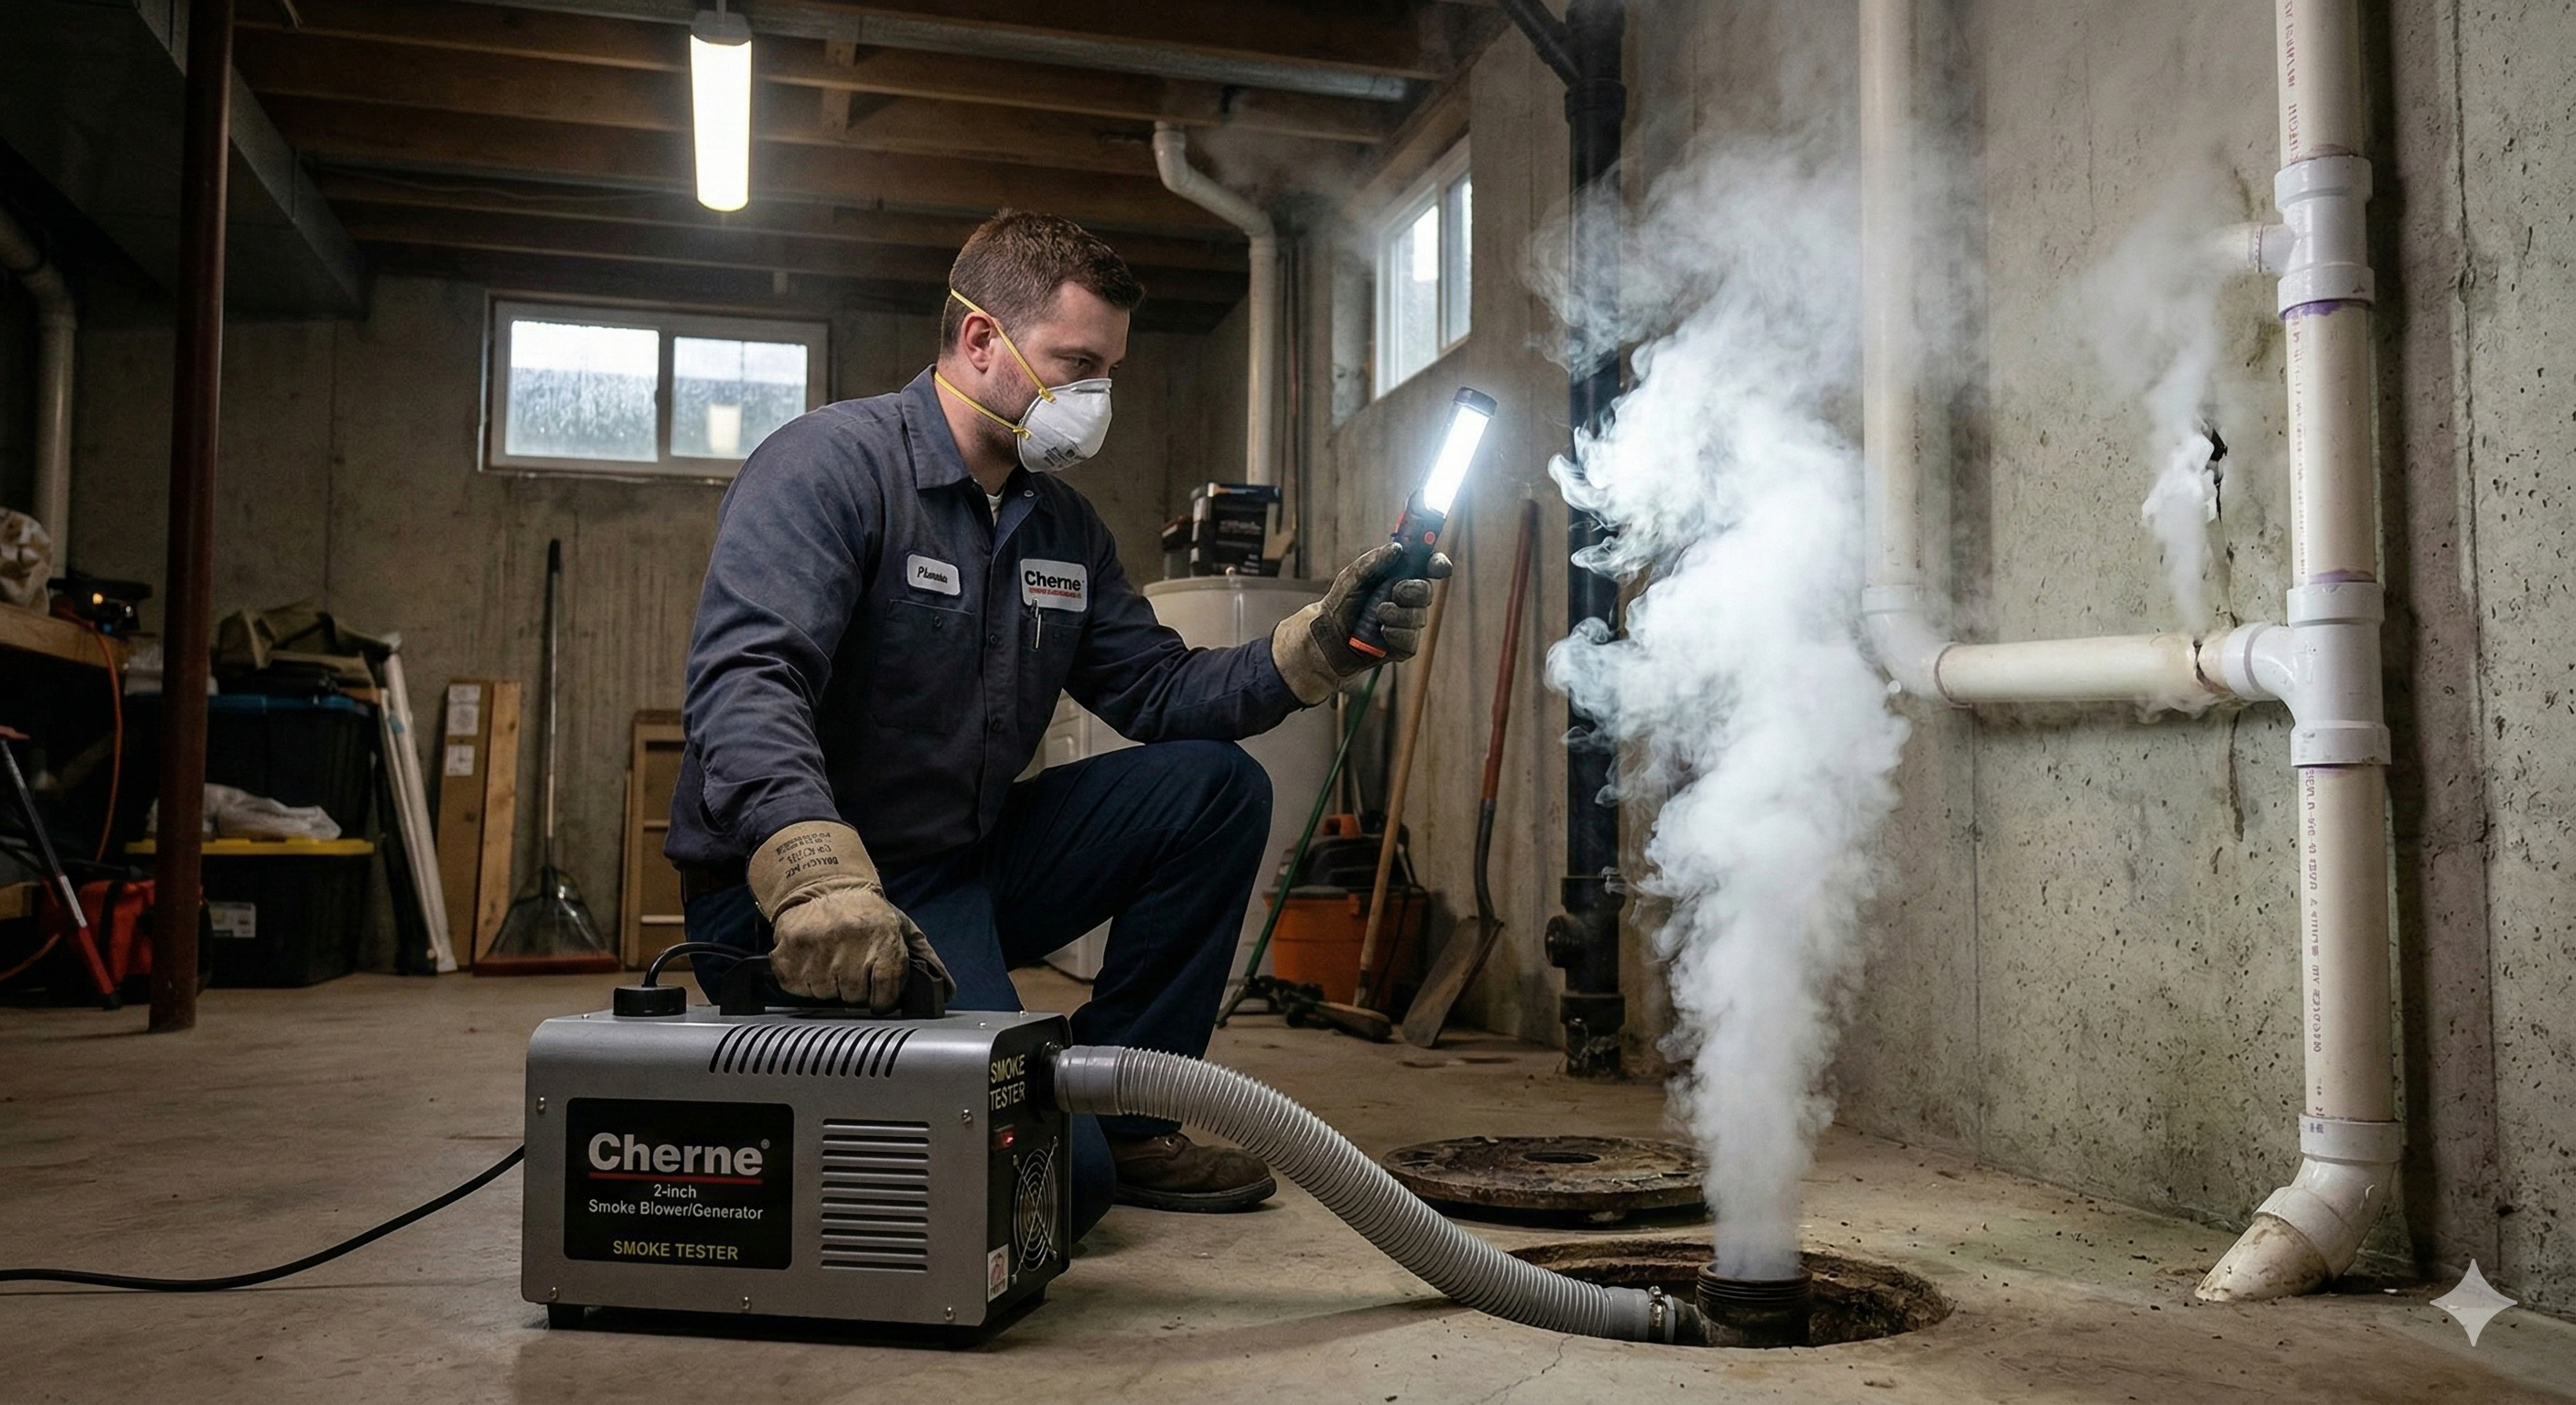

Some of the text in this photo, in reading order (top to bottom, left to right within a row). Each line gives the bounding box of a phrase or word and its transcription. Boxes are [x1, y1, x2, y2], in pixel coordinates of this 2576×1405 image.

[1025, 570, 1081, 591] Cherne
[991, 1054, 1025, 1084] SMOKE
[990, 1080, 1025, 1111] TESTER
[653, 1184, 697, 1198] 2-inch
[588, 1199, 763, 1219] Smoke Blower/Generator
[613, 1240, 738, 1260] SMOKE TESTER
